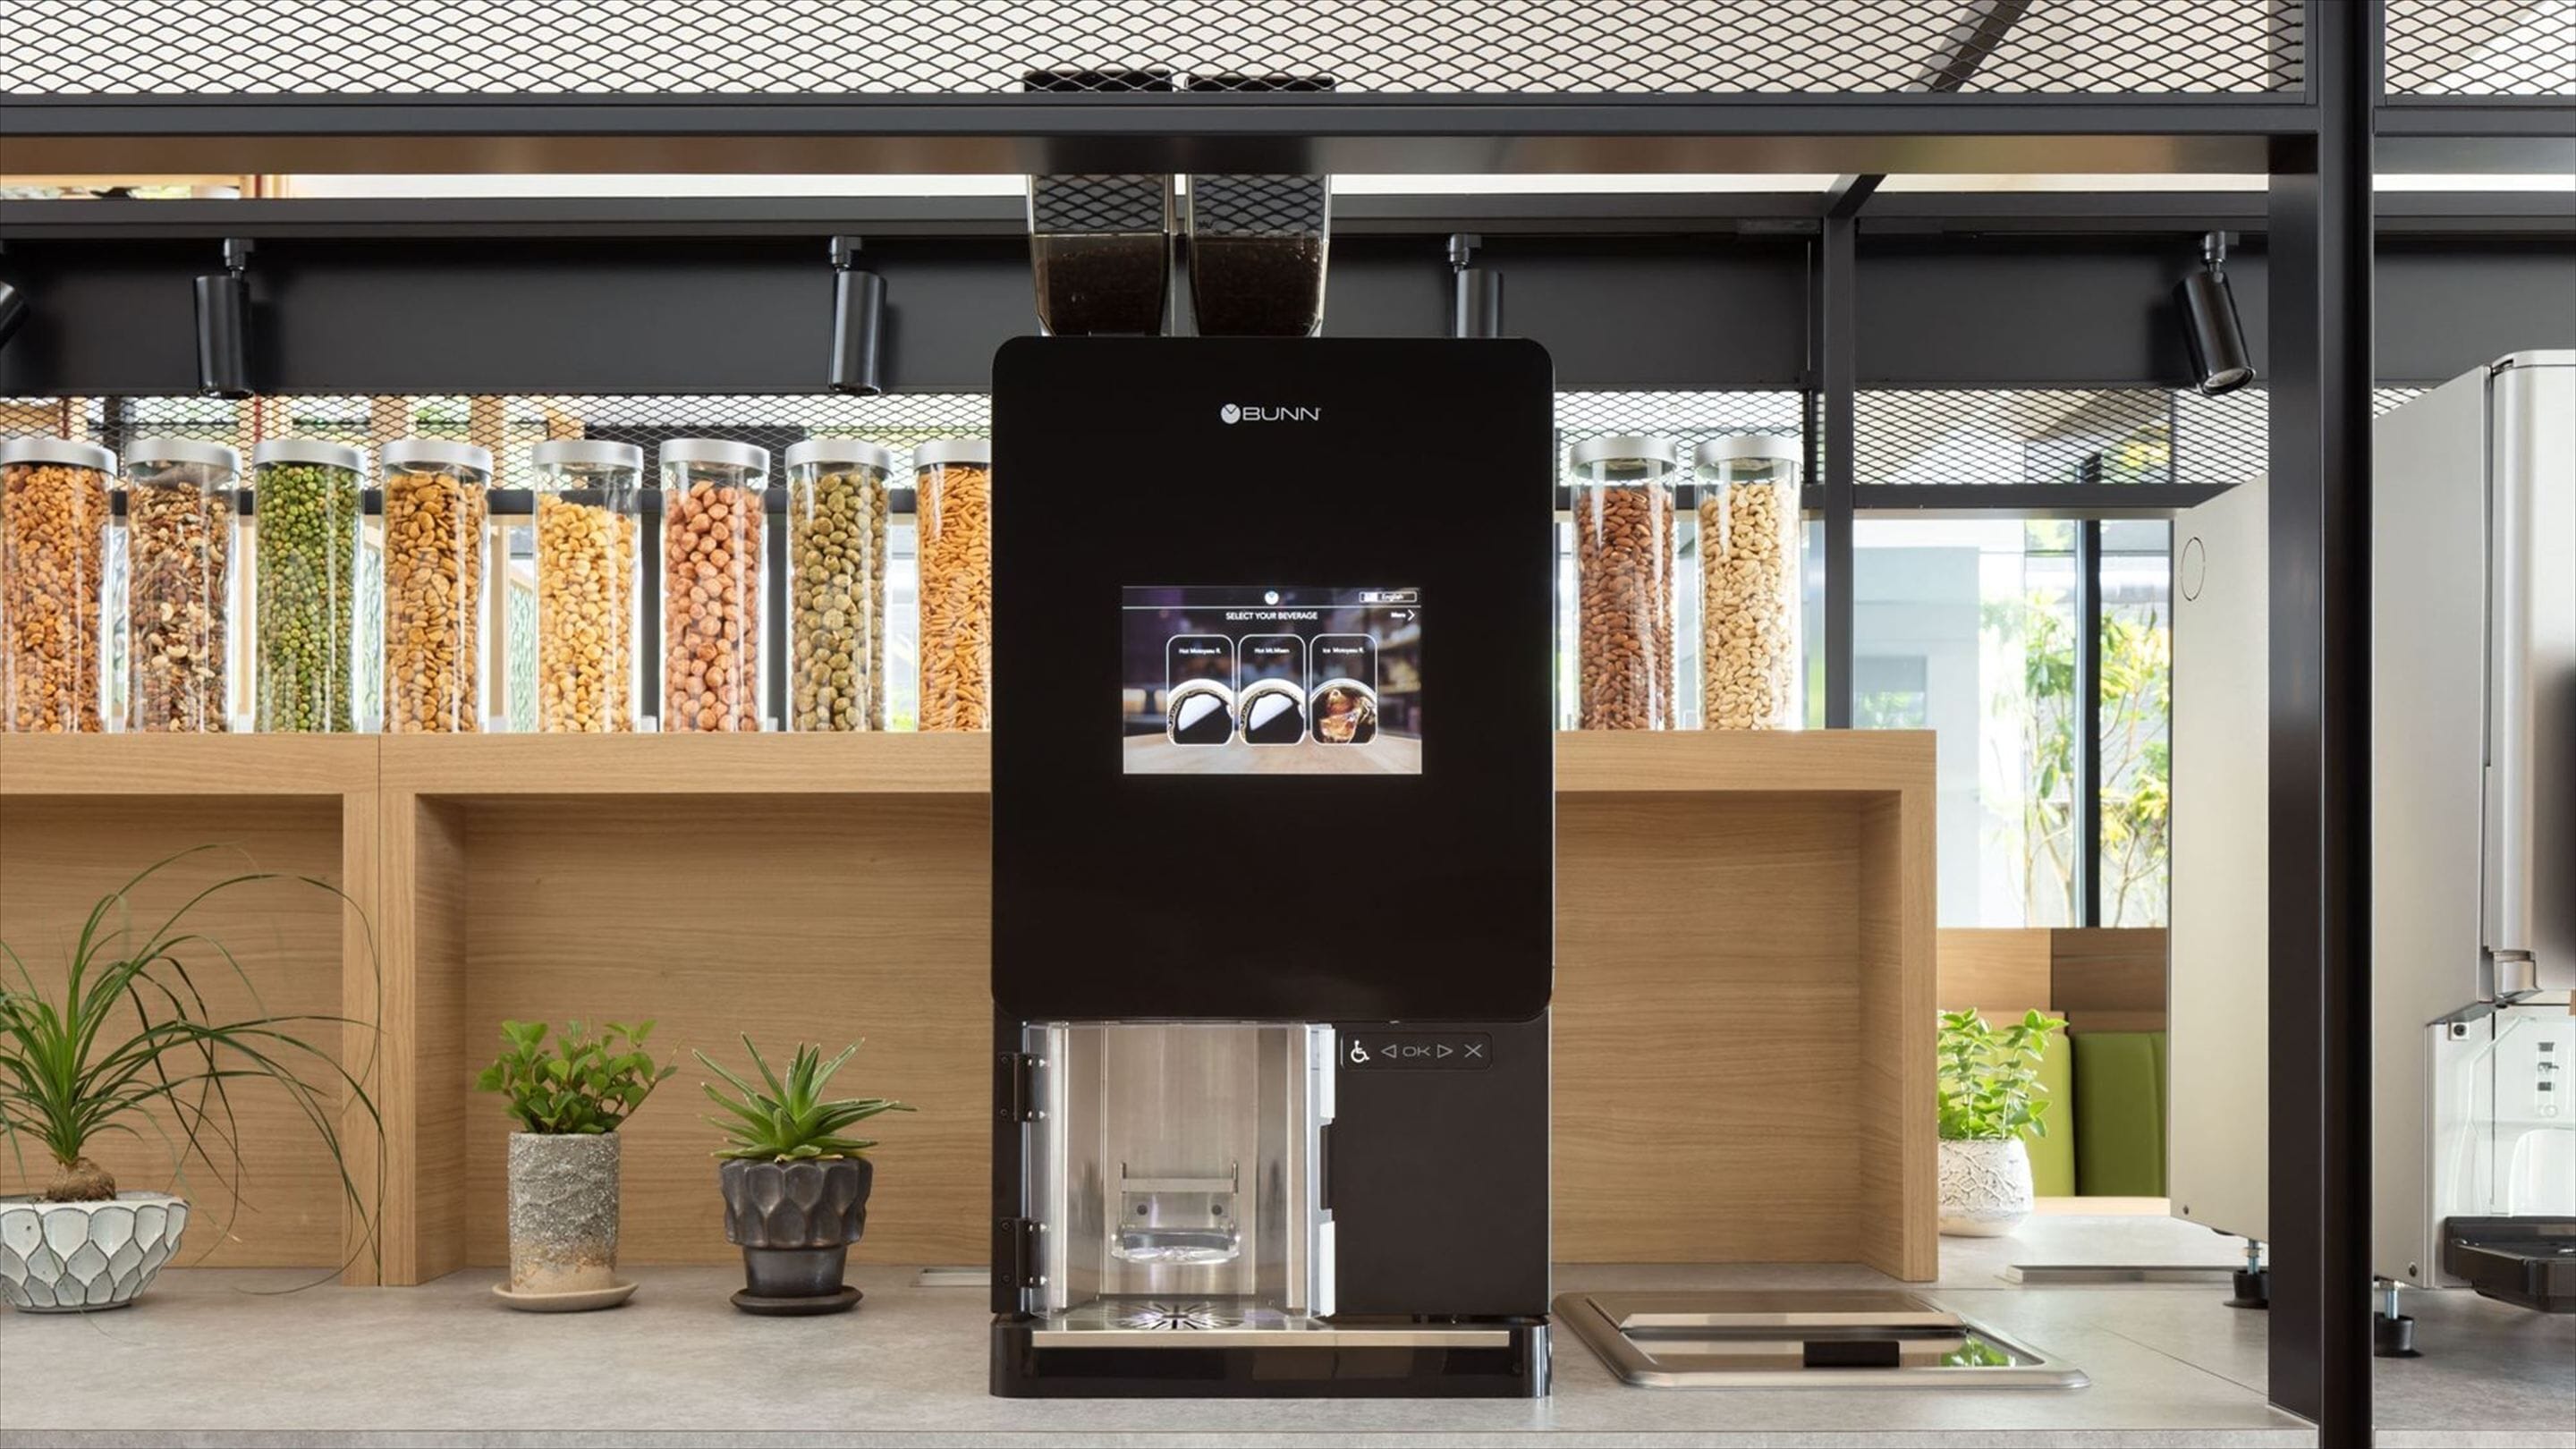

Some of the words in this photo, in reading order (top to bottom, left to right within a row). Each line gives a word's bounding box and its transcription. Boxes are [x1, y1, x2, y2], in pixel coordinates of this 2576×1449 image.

[1242, 407, 1320, 421] BUNN
[1225, 611, 1253, 620] SELECT
[1255, 611, 1277, 620] YOUR
[1277, 611, 1318, 620] BEVERAGE
[1402, 1046, 1431, 1057] OK
